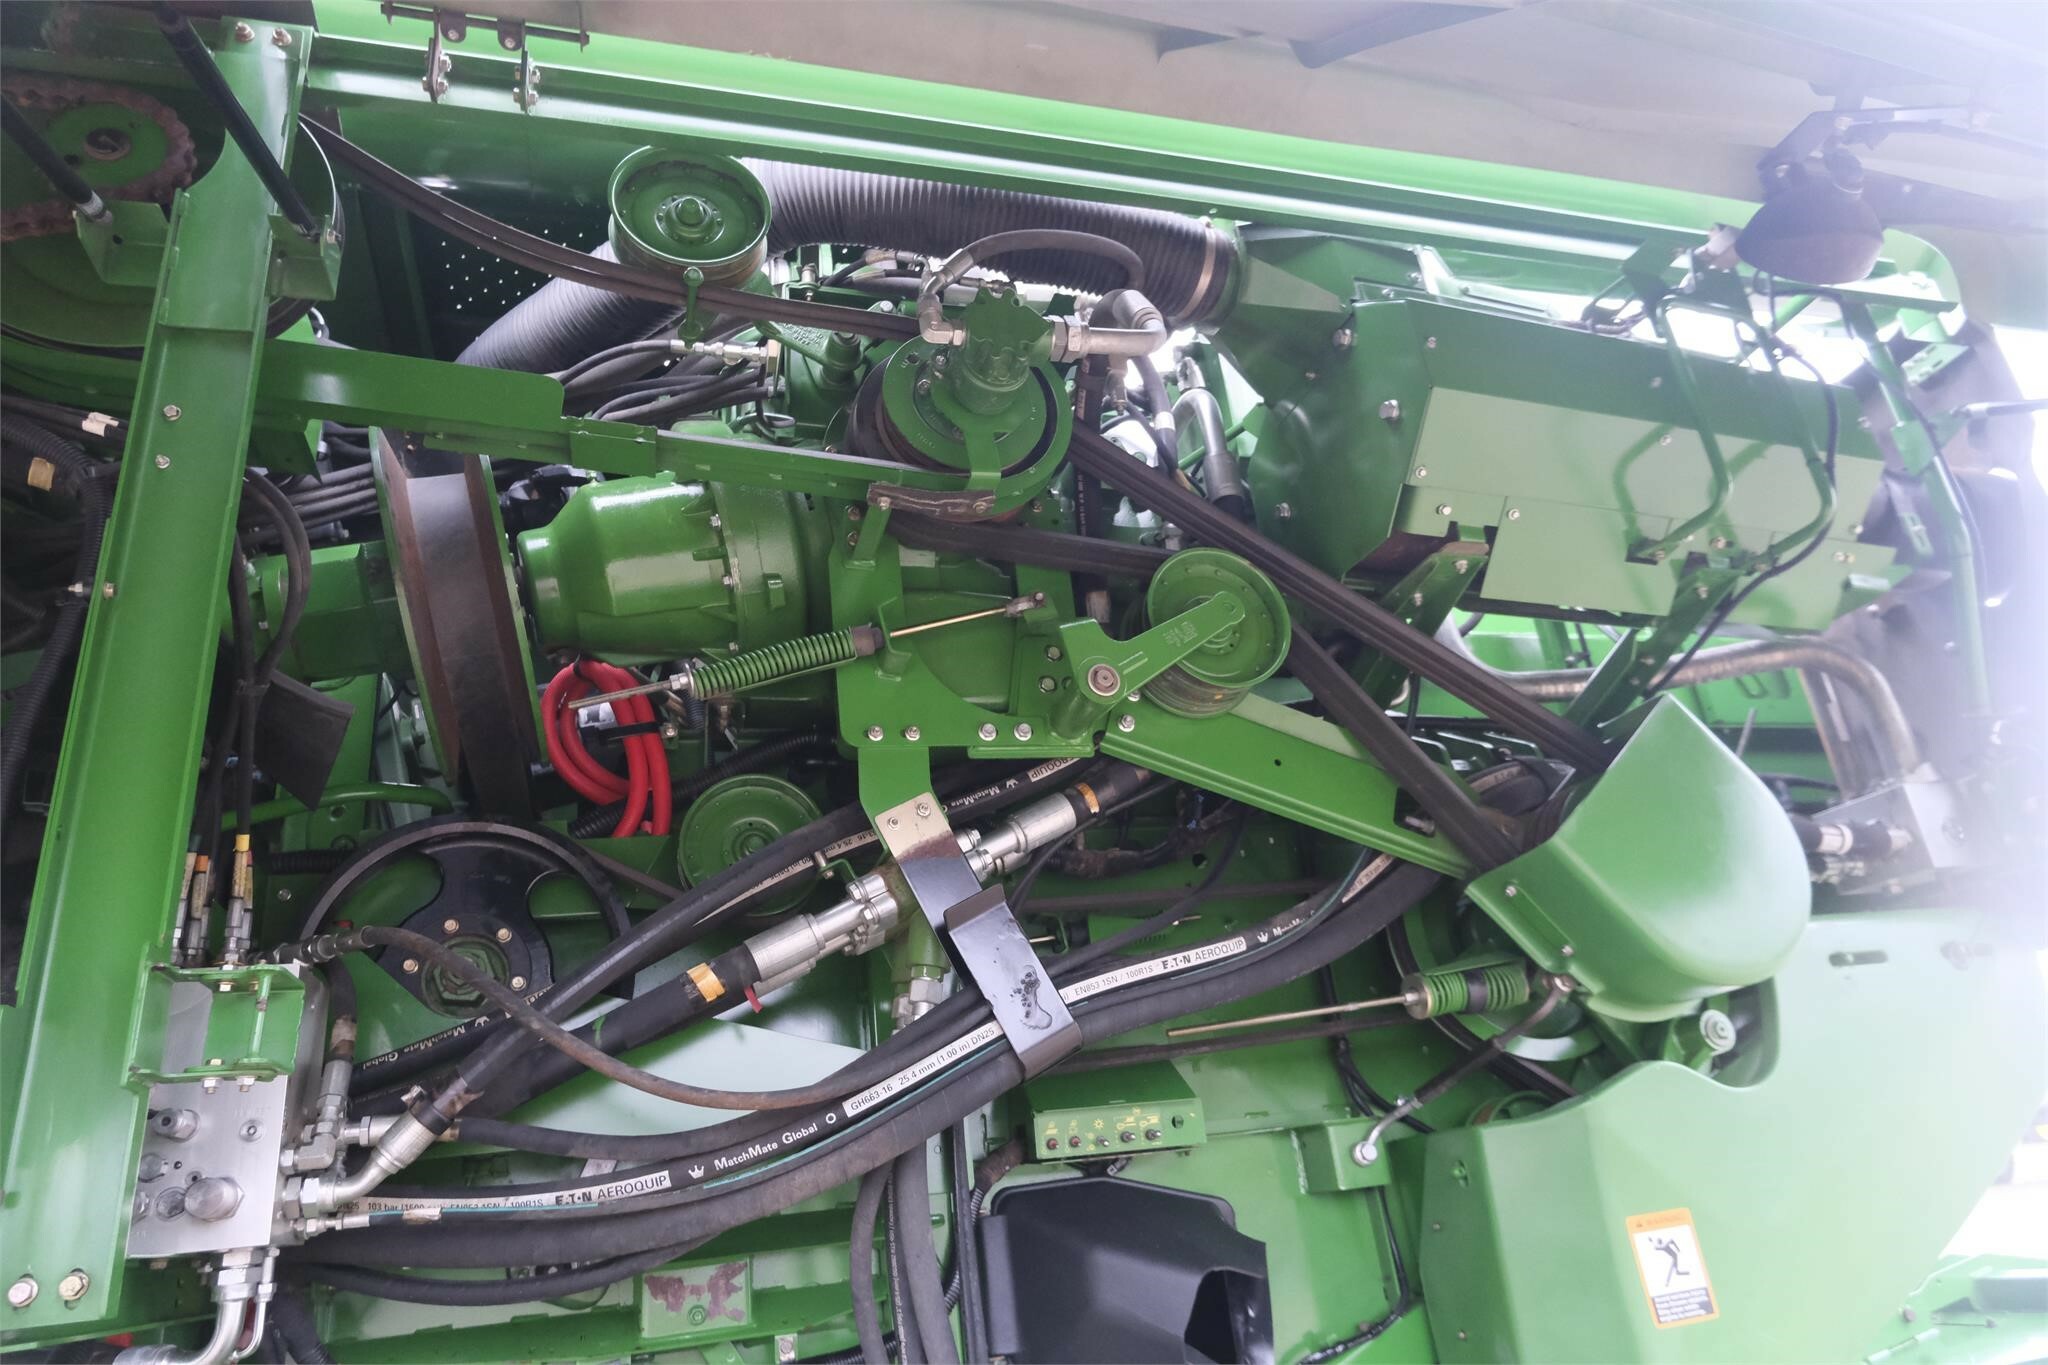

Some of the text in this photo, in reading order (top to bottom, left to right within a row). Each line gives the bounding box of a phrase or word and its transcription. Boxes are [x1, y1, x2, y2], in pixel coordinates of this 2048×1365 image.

[1074, 982, 1100, 996] EN853
[1194, 939, 1245, 962] AEROQUIP
[850, 1083, 894, 1111] GH663-16
[898, 1072, 917, 1086] 25.4
[918, 1061, 936, 1075] mm
[937, 1047, 958, 1066] (1.00
[972, 1027, 995, 1046] DN25
[713, 1122, 818, 1172] MatchMate Global
[597, 1174, 667, 1200] AEROQUIP
